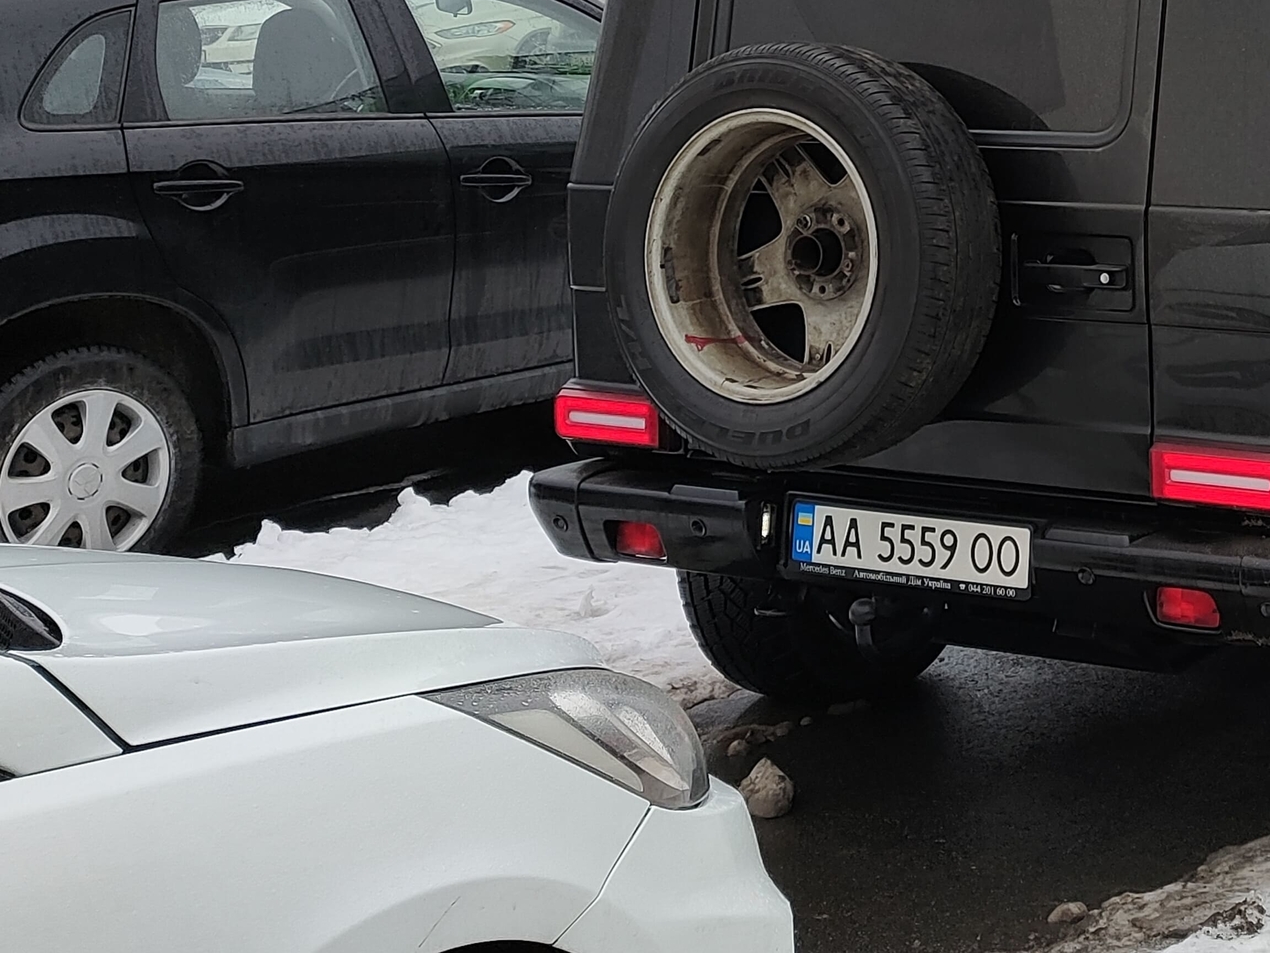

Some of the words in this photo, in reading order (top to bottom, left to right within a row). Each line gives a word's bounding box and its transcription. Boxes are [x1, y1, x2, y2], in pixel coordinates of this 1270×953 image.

[796, 539, 811, 554] UA
[816, 515, 862, 560] AA
[877, 521, 958, 570] 5559
[800, 562, 829, 574] Mercedes
[830, 566, 846, 576] Benz
[853, 570, 906, 584] Автомобільний
[908, 576, 921, 586] Дім
[923, 578, 951, 589] Україна
[968, 584, 980, 593] 044
[982, 586, 994, 595] 201
[996, 587, 1005, 596] 60
[1006, 589, 1016, 597] 00
